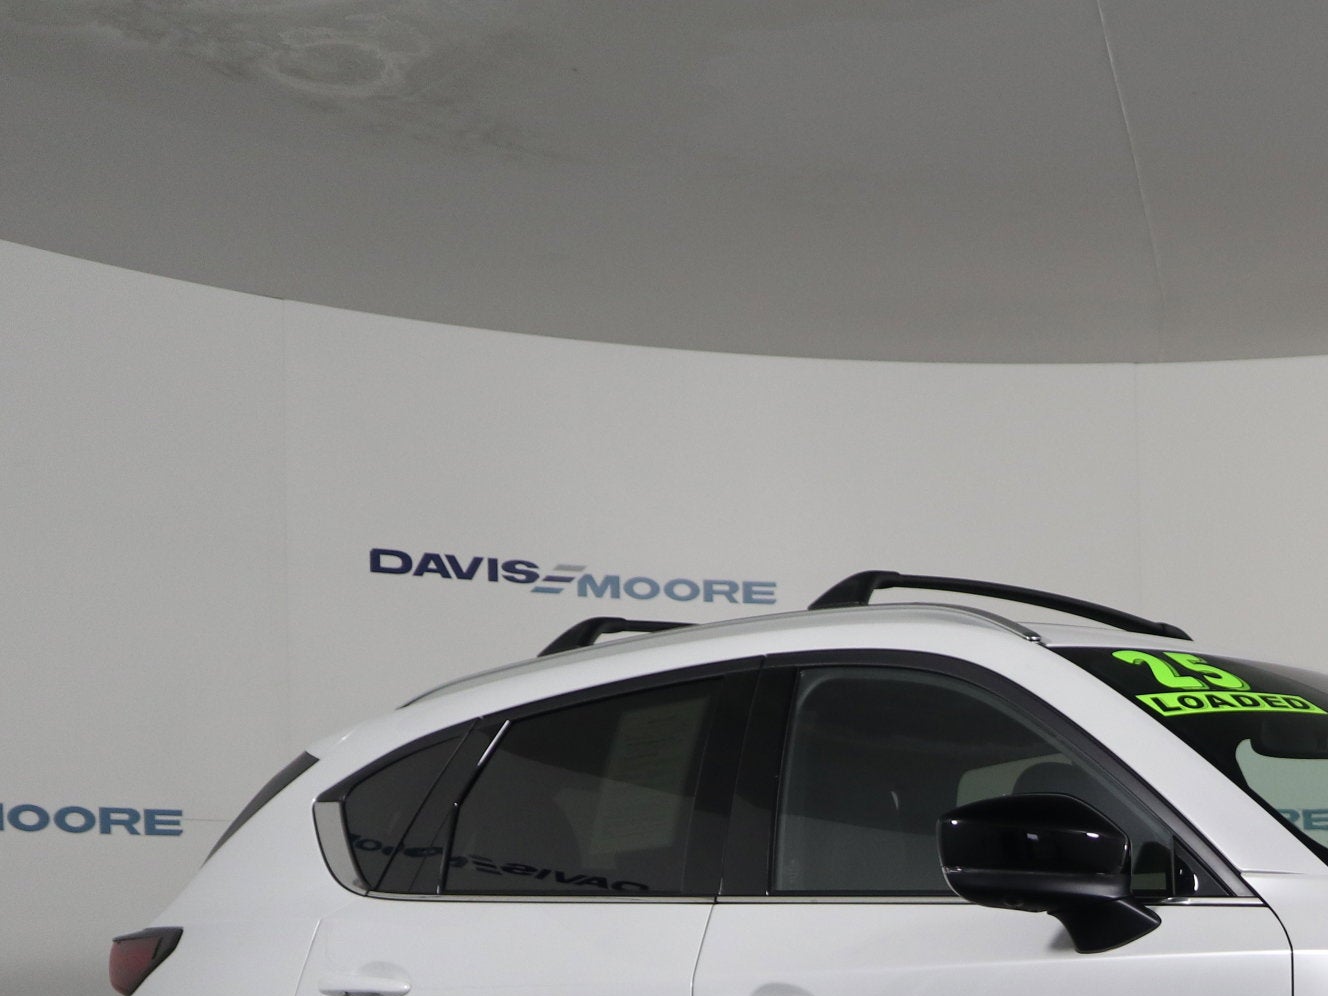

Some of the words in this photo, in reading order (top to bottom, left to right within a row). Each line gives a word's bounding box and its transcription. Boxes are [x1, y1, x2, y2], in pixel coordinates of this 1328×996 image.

[369, 548, 539, 584] DAVIS
[577, 573, 777, 604] MOORE
[1112, 650, 1251, 690] 25
[1151, 694, 1310, 712] LOADED
[0, 803, 183, 836] OORE
